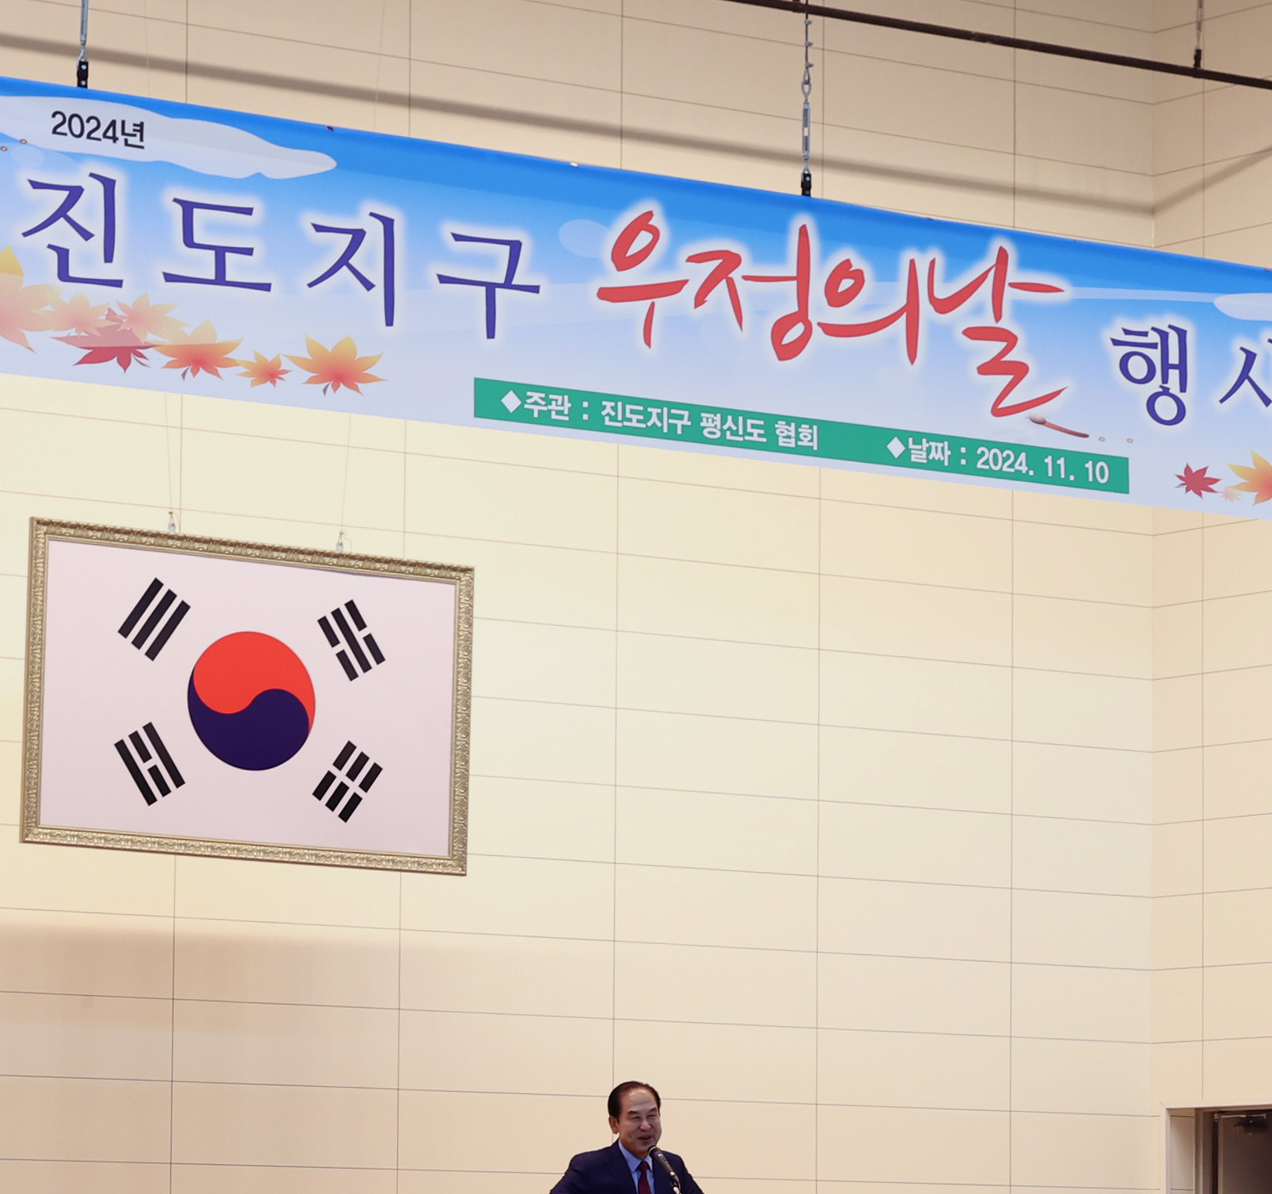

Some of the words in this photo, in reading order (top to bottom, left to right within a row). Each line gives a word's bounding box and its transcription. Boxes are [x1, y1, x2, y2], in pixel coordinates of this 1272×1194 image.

[50, 110, 146, 150] 2024년
[20, 172, 542, 341] 진도지구
[596, 209, 1068, 418] 우정의날
[523, 389, 572, 421] 주관
[600, 399, 693, 435] 진도지구
[699, 411, 768, 443] 평신도
[774, 420, 819, 451] 협회
[907, 436, 952, 466] 날짜
[1084, 460, 1111, 484] 10
